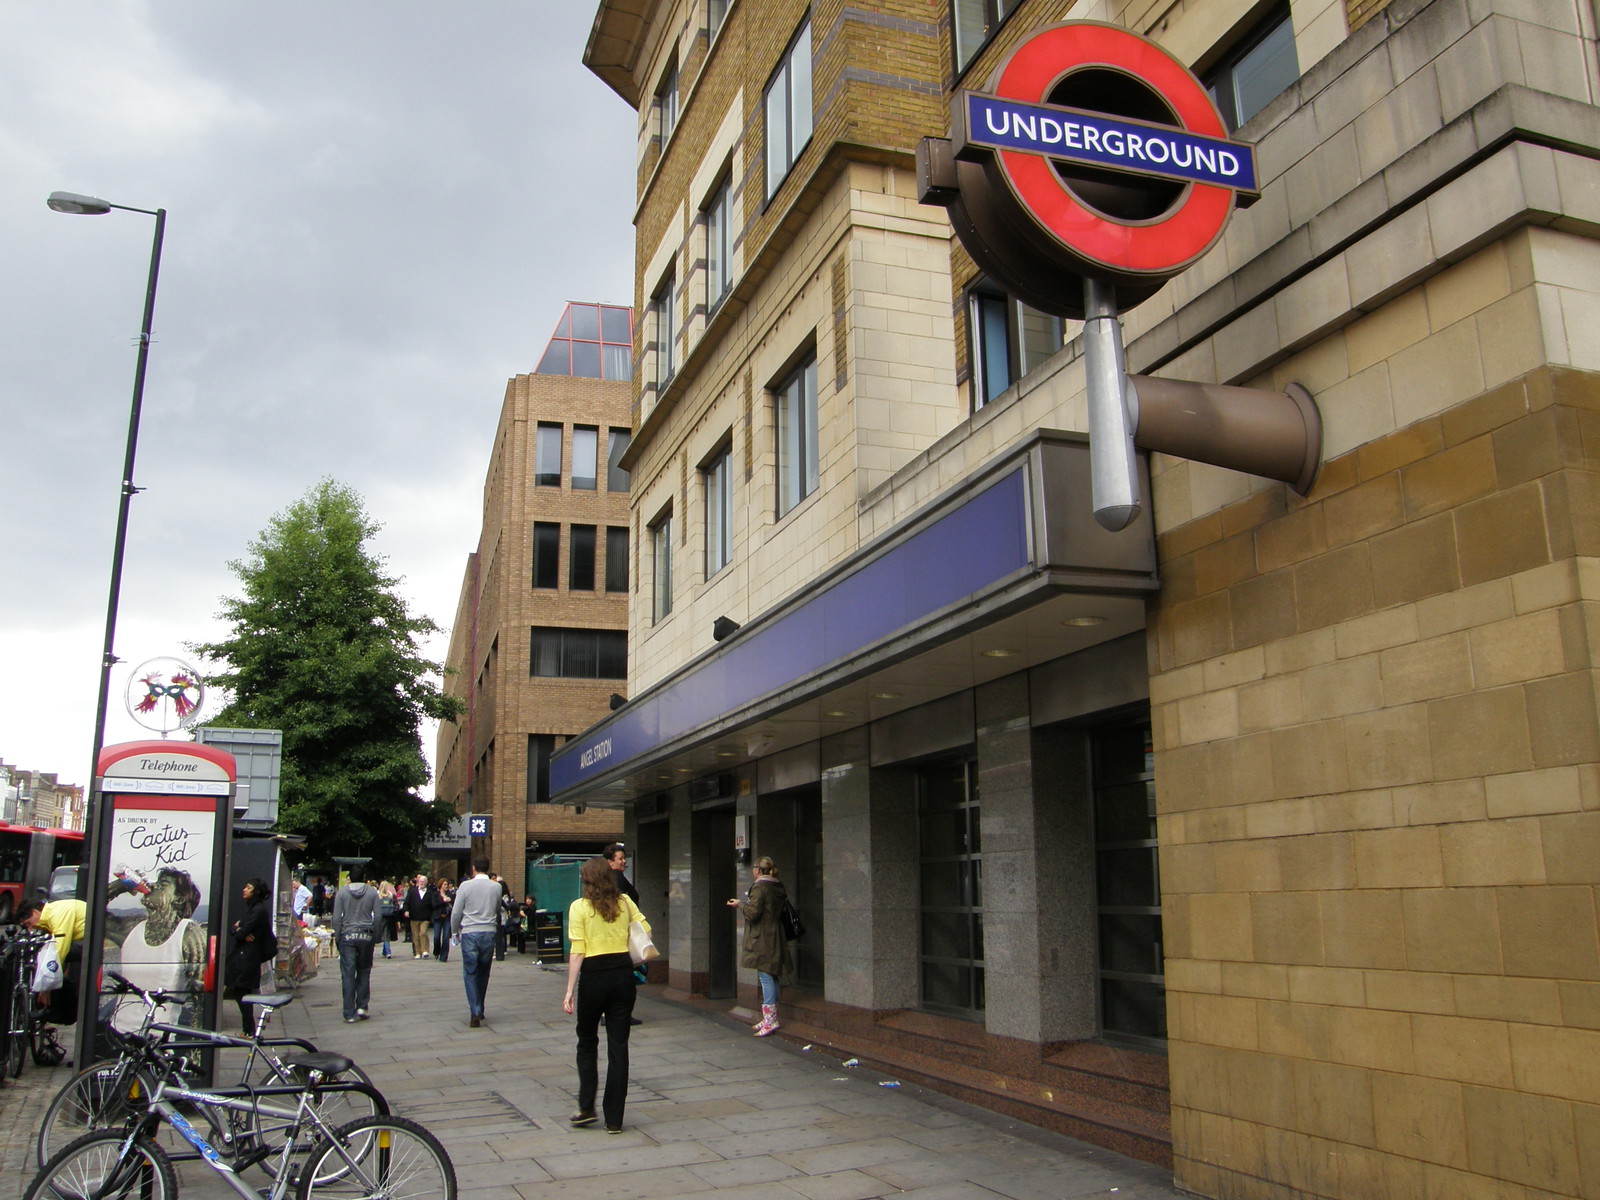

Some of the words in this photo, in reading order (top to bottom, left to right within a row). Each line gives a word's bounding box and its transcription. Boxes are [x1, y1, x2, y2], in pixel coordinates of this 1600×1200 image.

[985, 107, 1240, 177] UNDERGROUND
[140, 759, 198, 773] Telephone
[580, 748, 594, 769] ANGEL
[593, 737, 612, 763] STATION
[123, 824, 199, 849] Cactus
[148, 842, 194, 871] Kid
